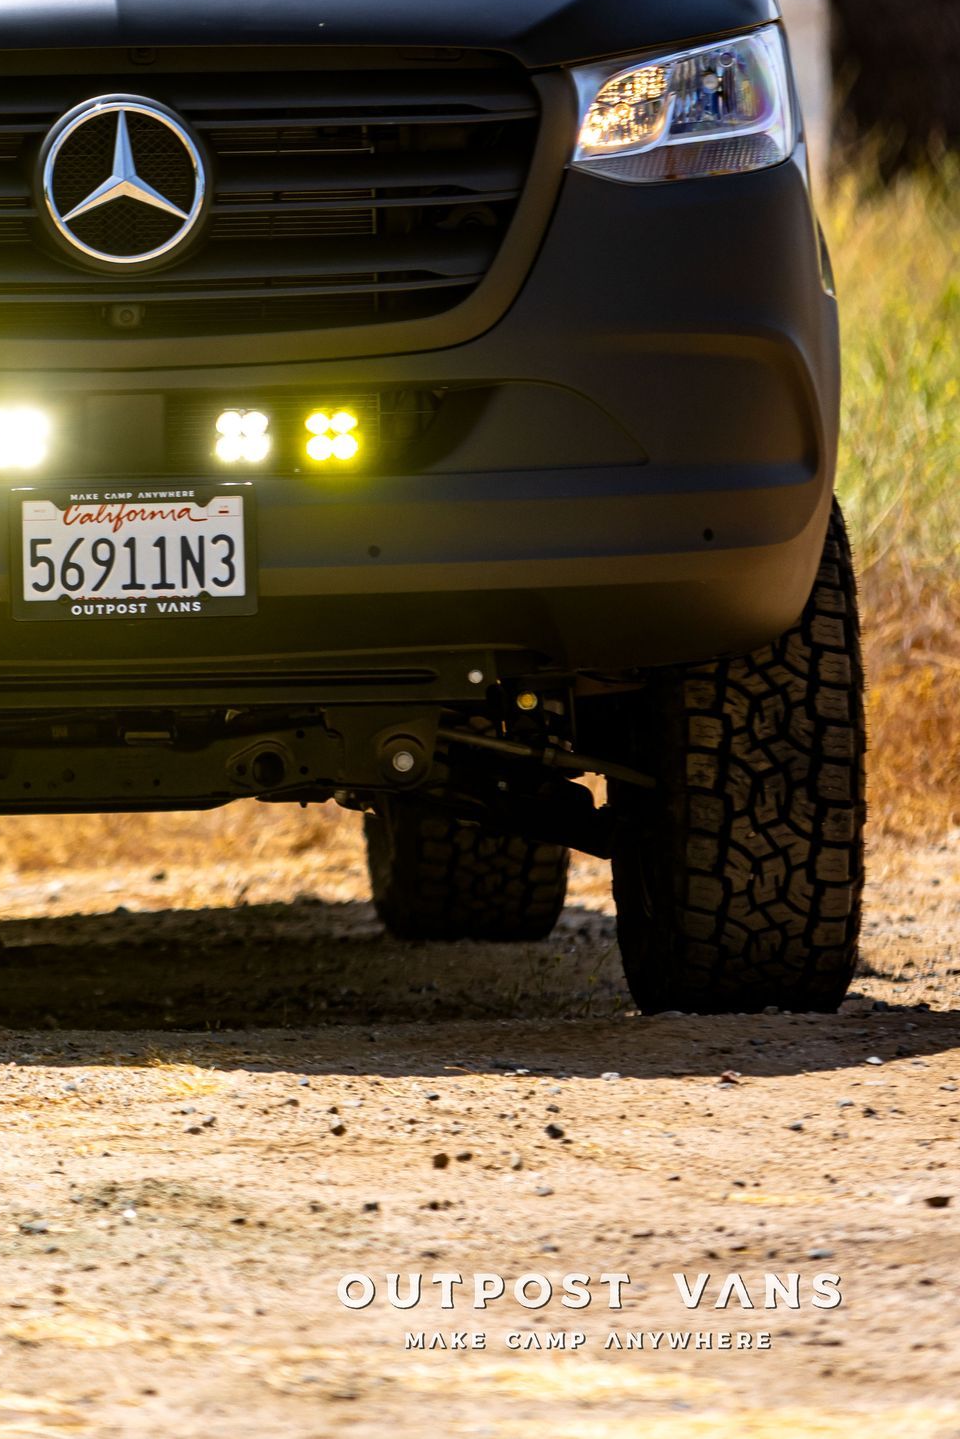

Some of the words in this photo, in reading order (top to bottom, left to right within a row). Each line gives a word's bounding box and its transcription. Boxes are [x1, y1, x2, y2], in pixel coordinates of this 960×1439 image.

[70, 493, 99, 501] MAKE
[104, 492, 133, 500] CAMP
[137, 490, 195, 499] ANYWHERE
[62, 502, 208, 533] California
[29, 534, 236, 593] 56911N3
[71, 603, 148, 616] OUTPOST
[157, 602, 201, 613] VANS
